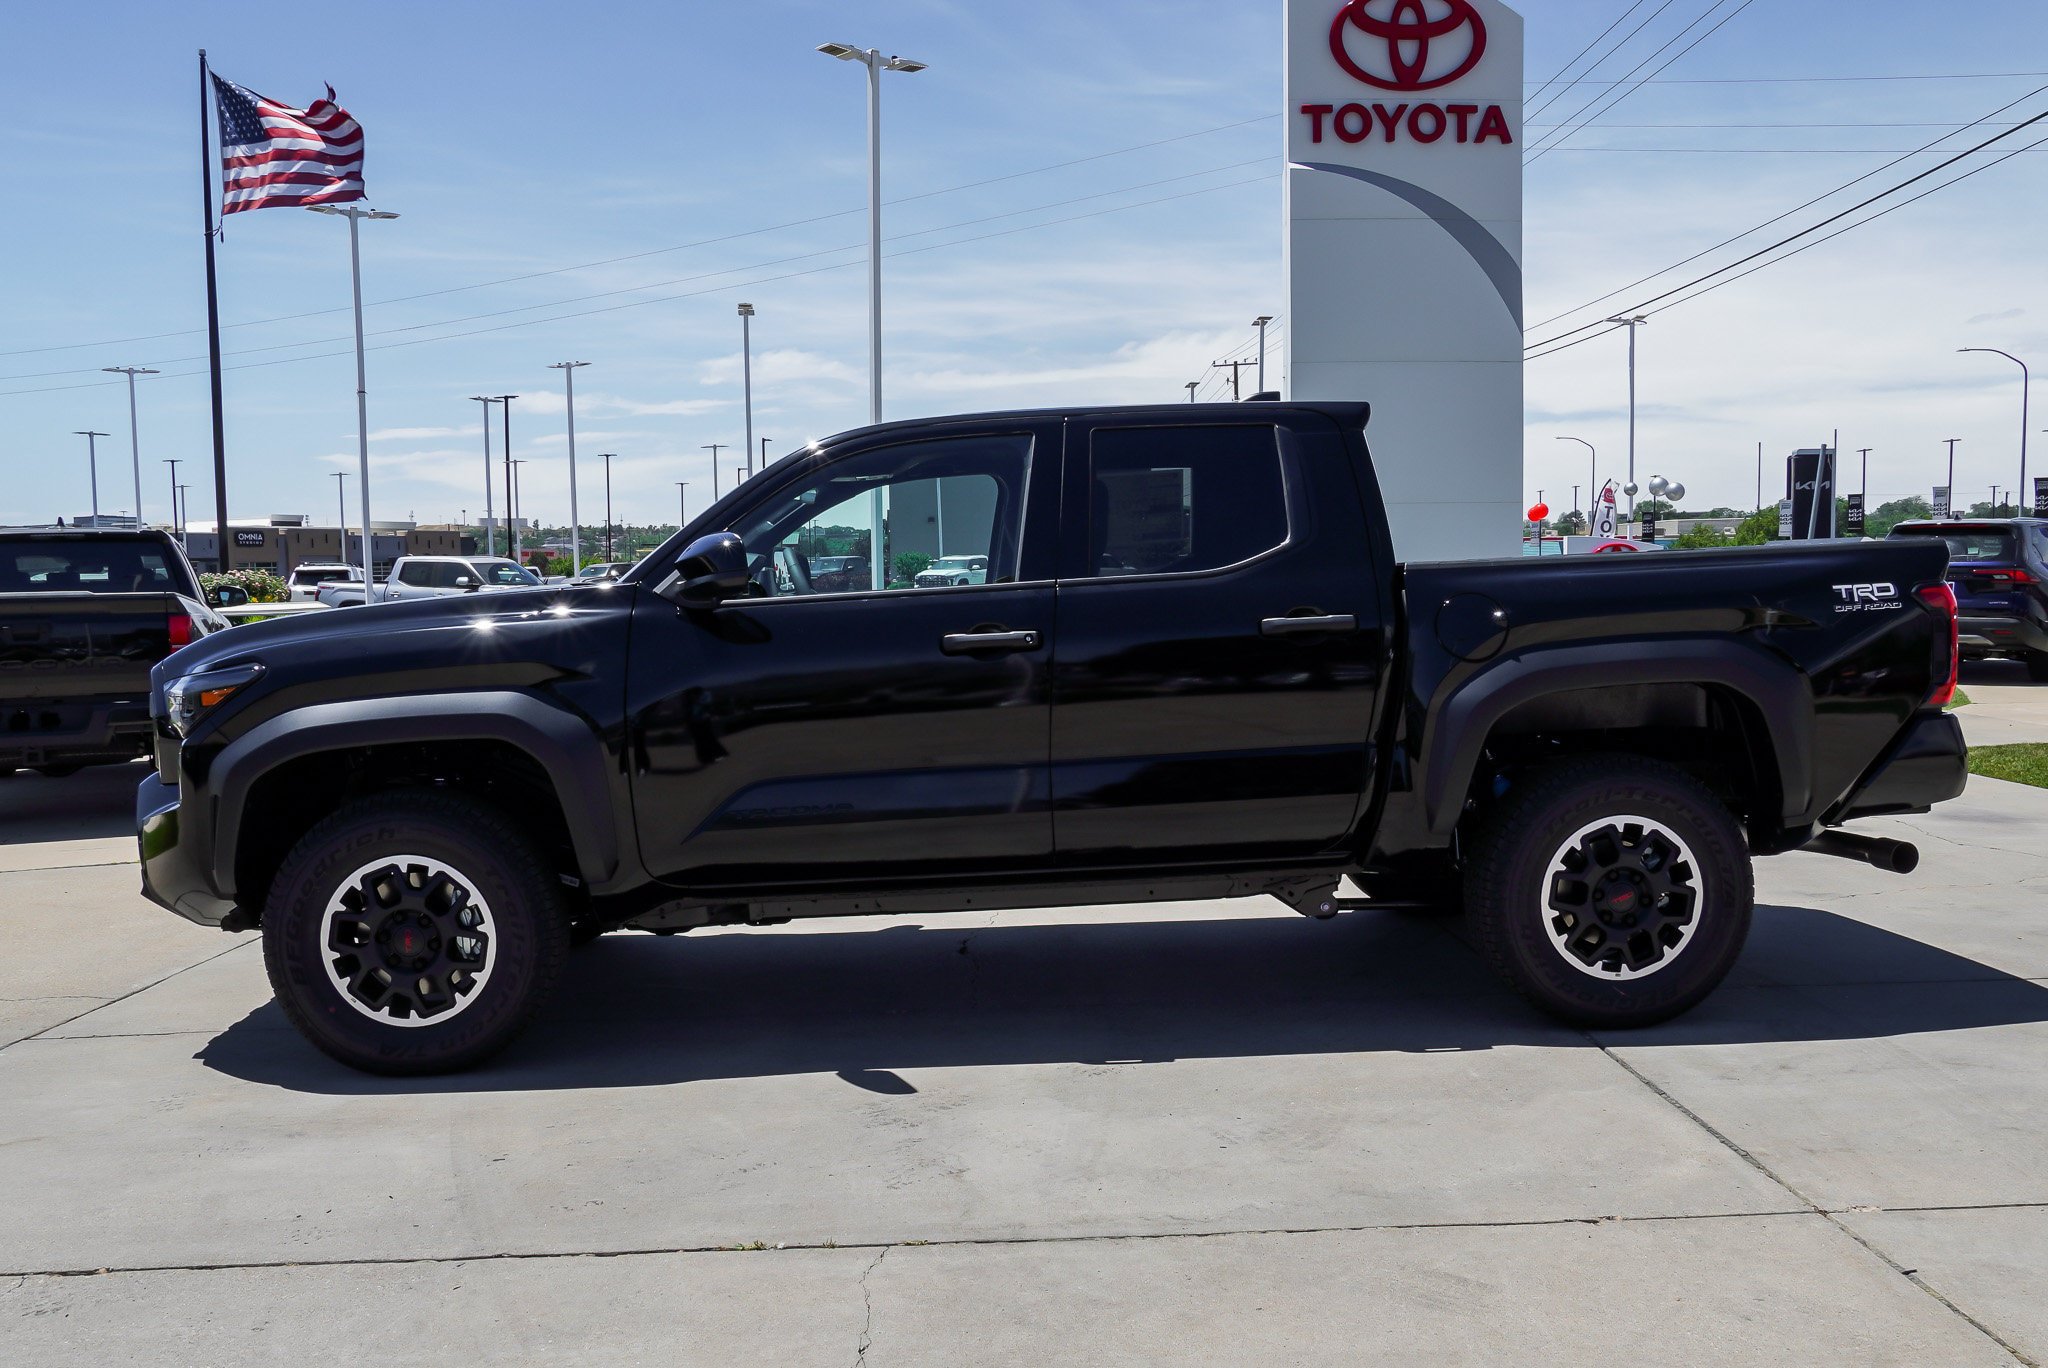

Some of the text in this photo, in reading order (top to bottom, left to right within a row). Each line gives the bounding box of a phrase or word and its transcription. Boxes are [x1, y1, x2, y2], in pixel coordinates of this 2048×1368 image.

[1301, 102, 1513, 144] TOYOTA
[1600, 506, 1613, 537] TO
[238, 533, 263, 541] OMNIA
[1832, 582, 1896, 602] TRD
[1834, 602, 1902, 613] OFF ROAD
[727, 801, 854, 821] TACOMA
[286, 827, 397, 986] BFGoodrich
